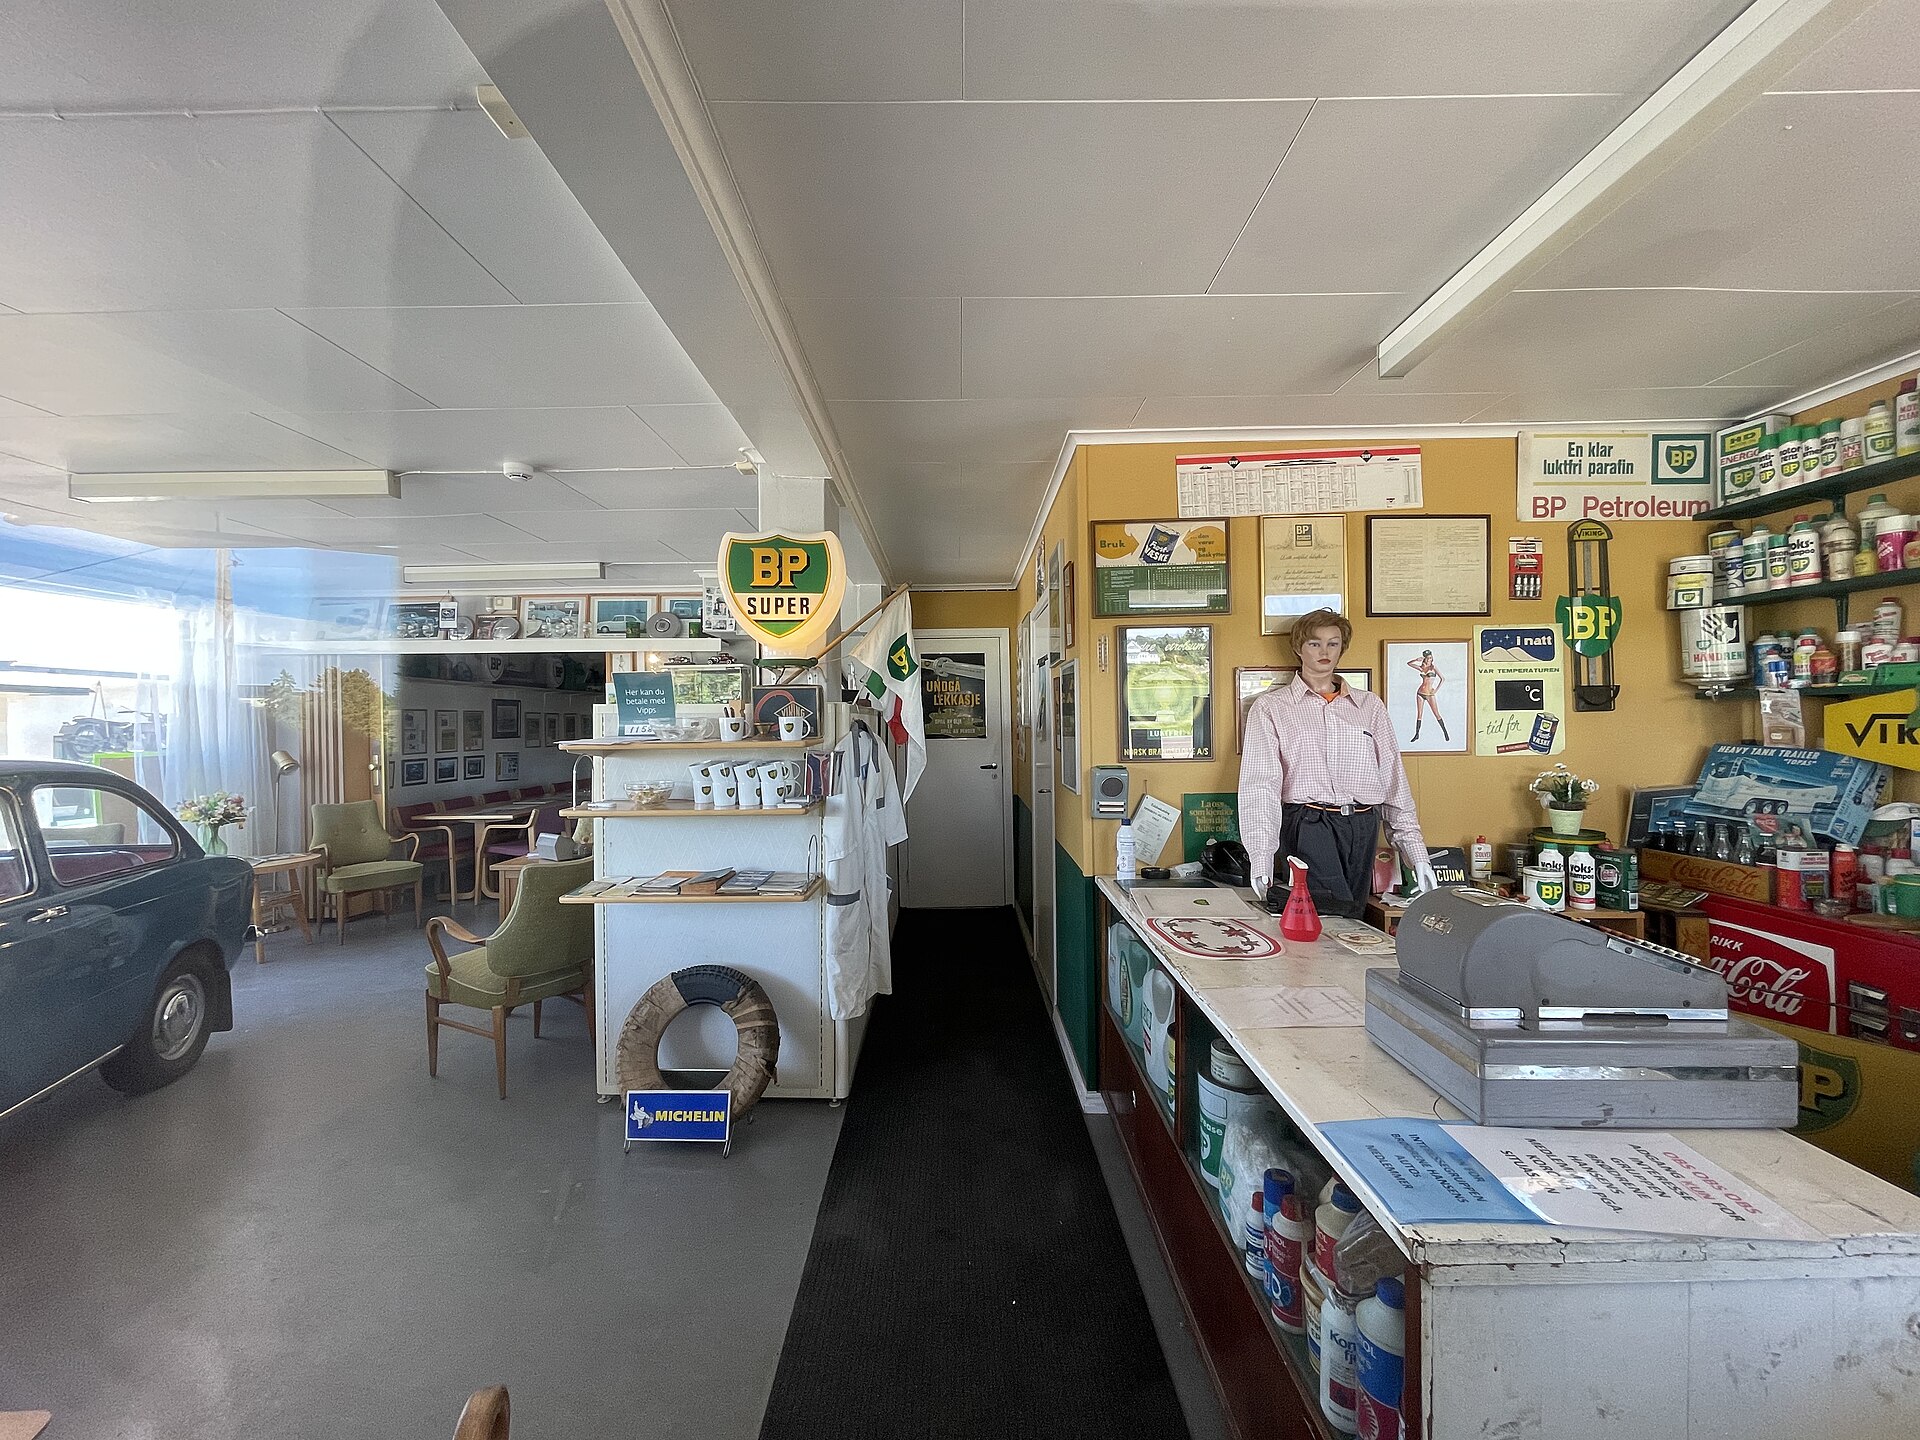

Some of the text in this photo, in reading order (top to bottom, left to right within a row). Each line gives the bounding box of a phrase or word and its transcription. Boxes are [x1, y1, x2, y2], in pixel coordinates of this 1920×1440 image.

[1730, 432, 1756, 444] HD
[1874, 437, 1894, 450] BP
[1568, 441, 1613, 458] En klar
[1671, 450, 1695, 467] BP
[1804, 459, 1818, 469] BP
[1821, 453, 1836, 464] BP
[1543, 459, 1634, 477] luktfri parafin
[1783, 463, 1799, 474] BP
[1734, 470, 1754, 485] BP
[1532, 495, 1711, 518] BP Petroleum
[1296, 525, 1309, 535] BP
[1573, 528, 1605, 539] VIKING
[1100, 540, 1126, 549] Bruk
[1790, 538, 1814, 550] oks-
[750, 547, 811, 589] BP
[1771, 566, 1786, 575] BP
[1792, 559, 1808, 570] BP
[747, 596, 810, 616] SUPER
[1565, 604, 1618, 641] BP
[1516, 635, 1553, 646] i natt
[625, 688, 665, 696] Her kan du
[926, 676, 961, 693] UNDGÅ
[625, 697, 666, 706] betale med
[933, 693, 981, 707] LEKKASJE
[636, 706, 657, 715] Vipps
[1717, 745, 1821, 761] HEAVY TANK TRAILER
[1540, 860, 1564, 870] voks-
[1570, 863, 1594, 874] voks-
[1671, 857, 1764, 897] Coca-Cola
[1541, 885, 1562, 900] BP
[1575, 883, 1590, 892] BP
[1711, 935, 1744, 952] RIKK
[1801, 1061, 1844, 1110] P
[655, 1110, 725, 1122] MICHELIN
[1365, 1144, 1414, 1190] MEDLEMMER
[1567, 1154, 1626, 1195] HANSENS
[1524, 1137, 1624, 1214] MEDLEMMER PGA.
[1584, 1153, 1653, 1200] BRØDRENE
[1610, 1157, 1672, 1199] GRUPPEN
[1628, 1156, 1698, 1202] INTERESSE
[1628, 1143, 1683, 1180] ADGANG
[1711, 1201, 1747, 1223] FOR
[1427, 1168, 1472, 1203] HANSENS
[1663, 1151, 1763, 1216] OBS OBS OBS
